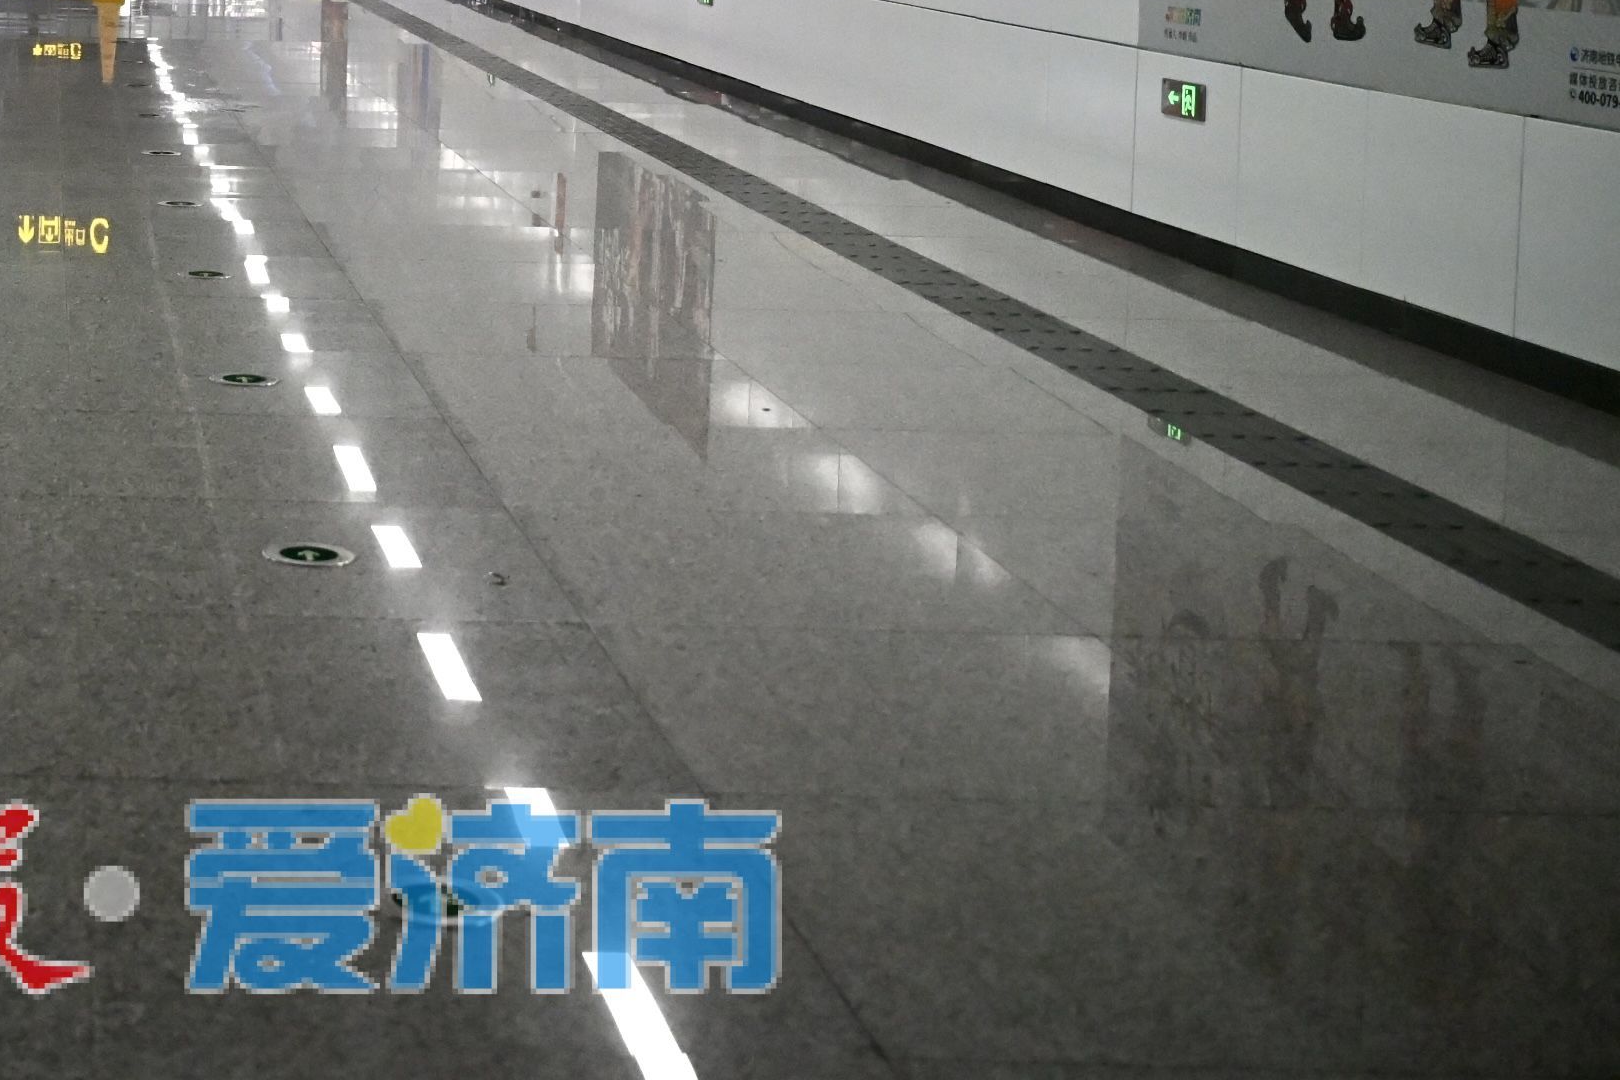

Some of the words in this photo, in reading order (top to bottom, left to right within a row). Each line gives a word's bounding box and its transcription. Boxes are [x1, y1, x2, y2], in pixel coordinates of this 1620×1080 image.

[1569, 72, 1620, 92] 媒体投放咨
